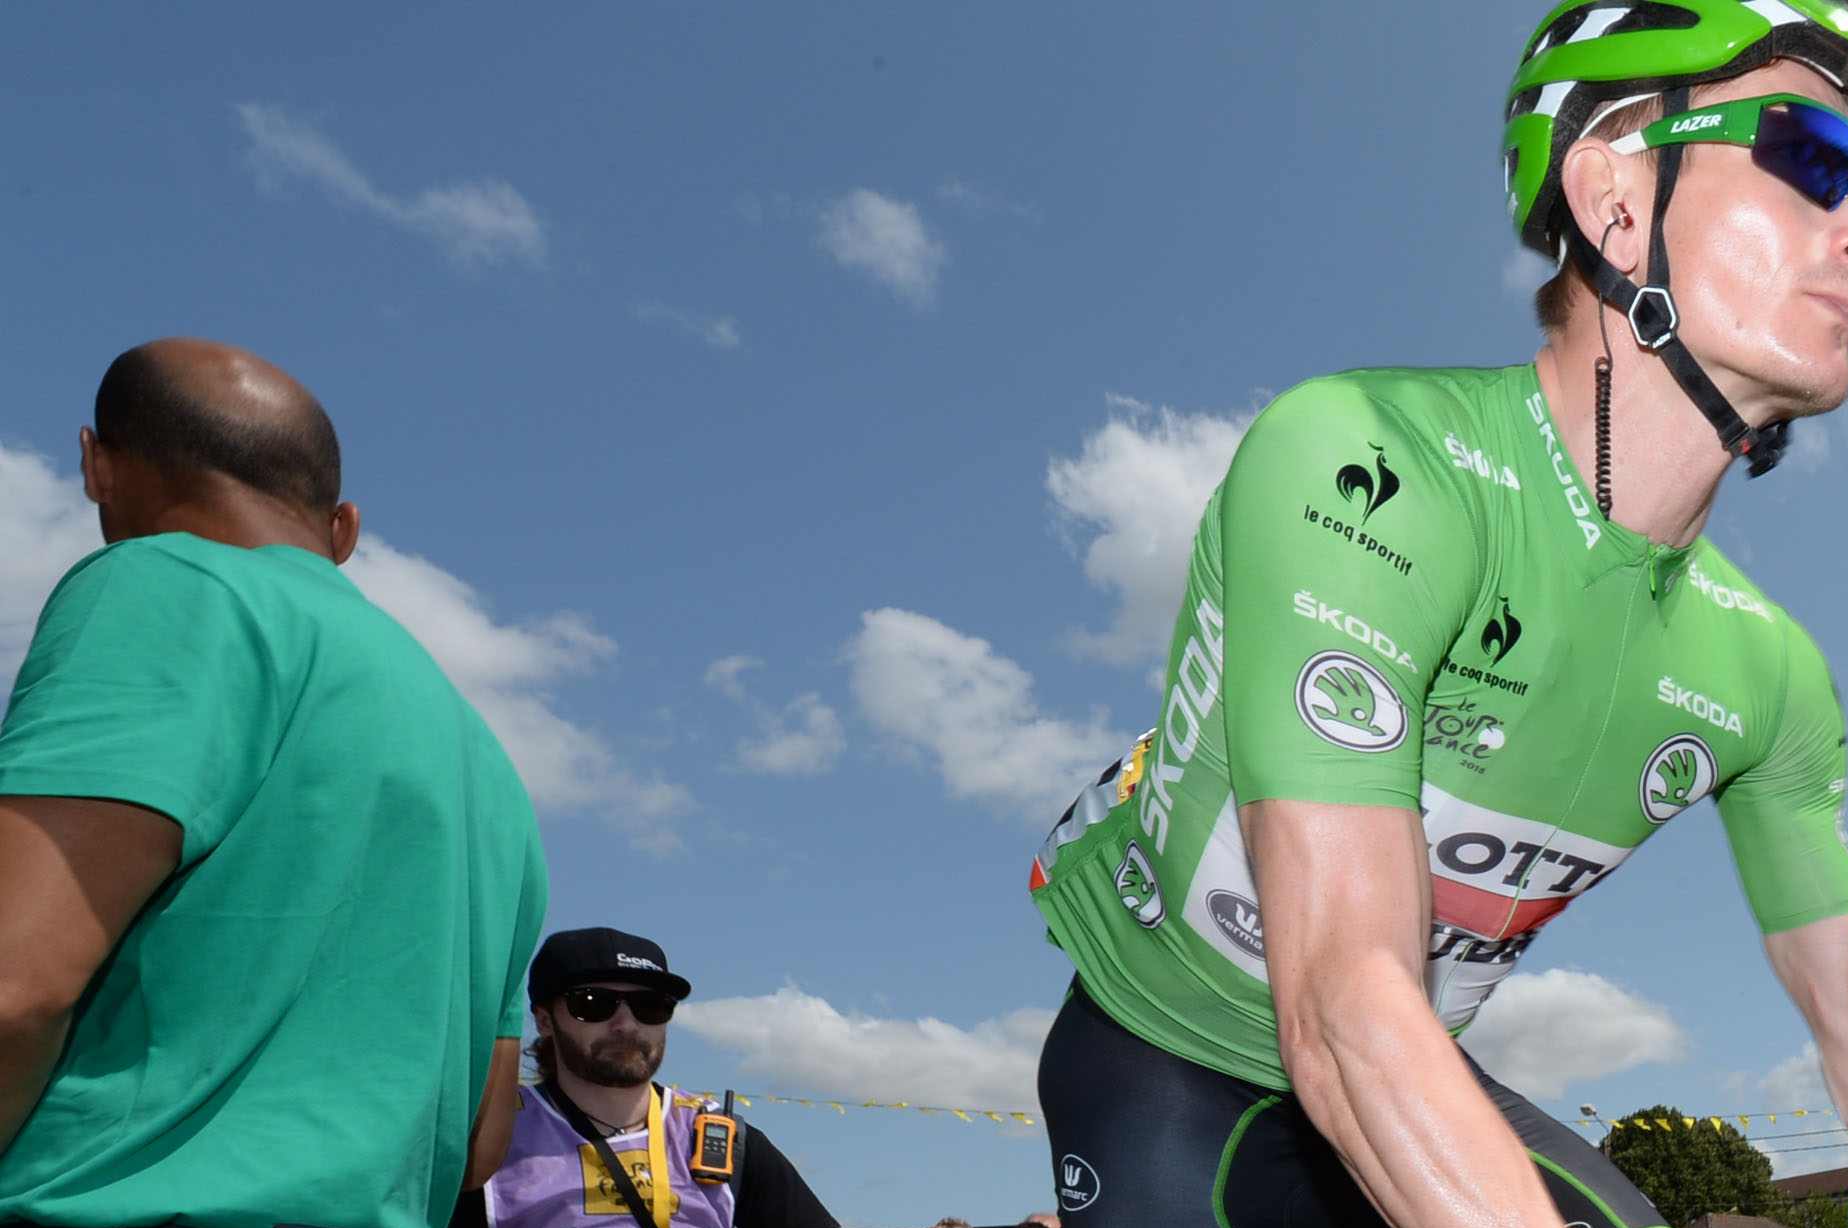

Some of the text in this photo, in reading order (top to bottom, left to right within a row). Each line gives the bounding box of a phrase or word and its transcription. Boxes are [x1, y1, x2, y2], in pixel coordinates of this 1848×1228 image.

[1670, 113, 1722, 134] LAZER
[1304, 504, 1413, 577] le coq sportif
[1293, 590, 1419, 674] ŠKODA
[1443, 657, 1528, 696] le coq sportif
[1657, 676, 1744, 738] ŠKODA
[1425, 735, 1491, 759] ance
[1422, 805, 1618, 893] OTT
[1216, 912, 1263, 950] verma
